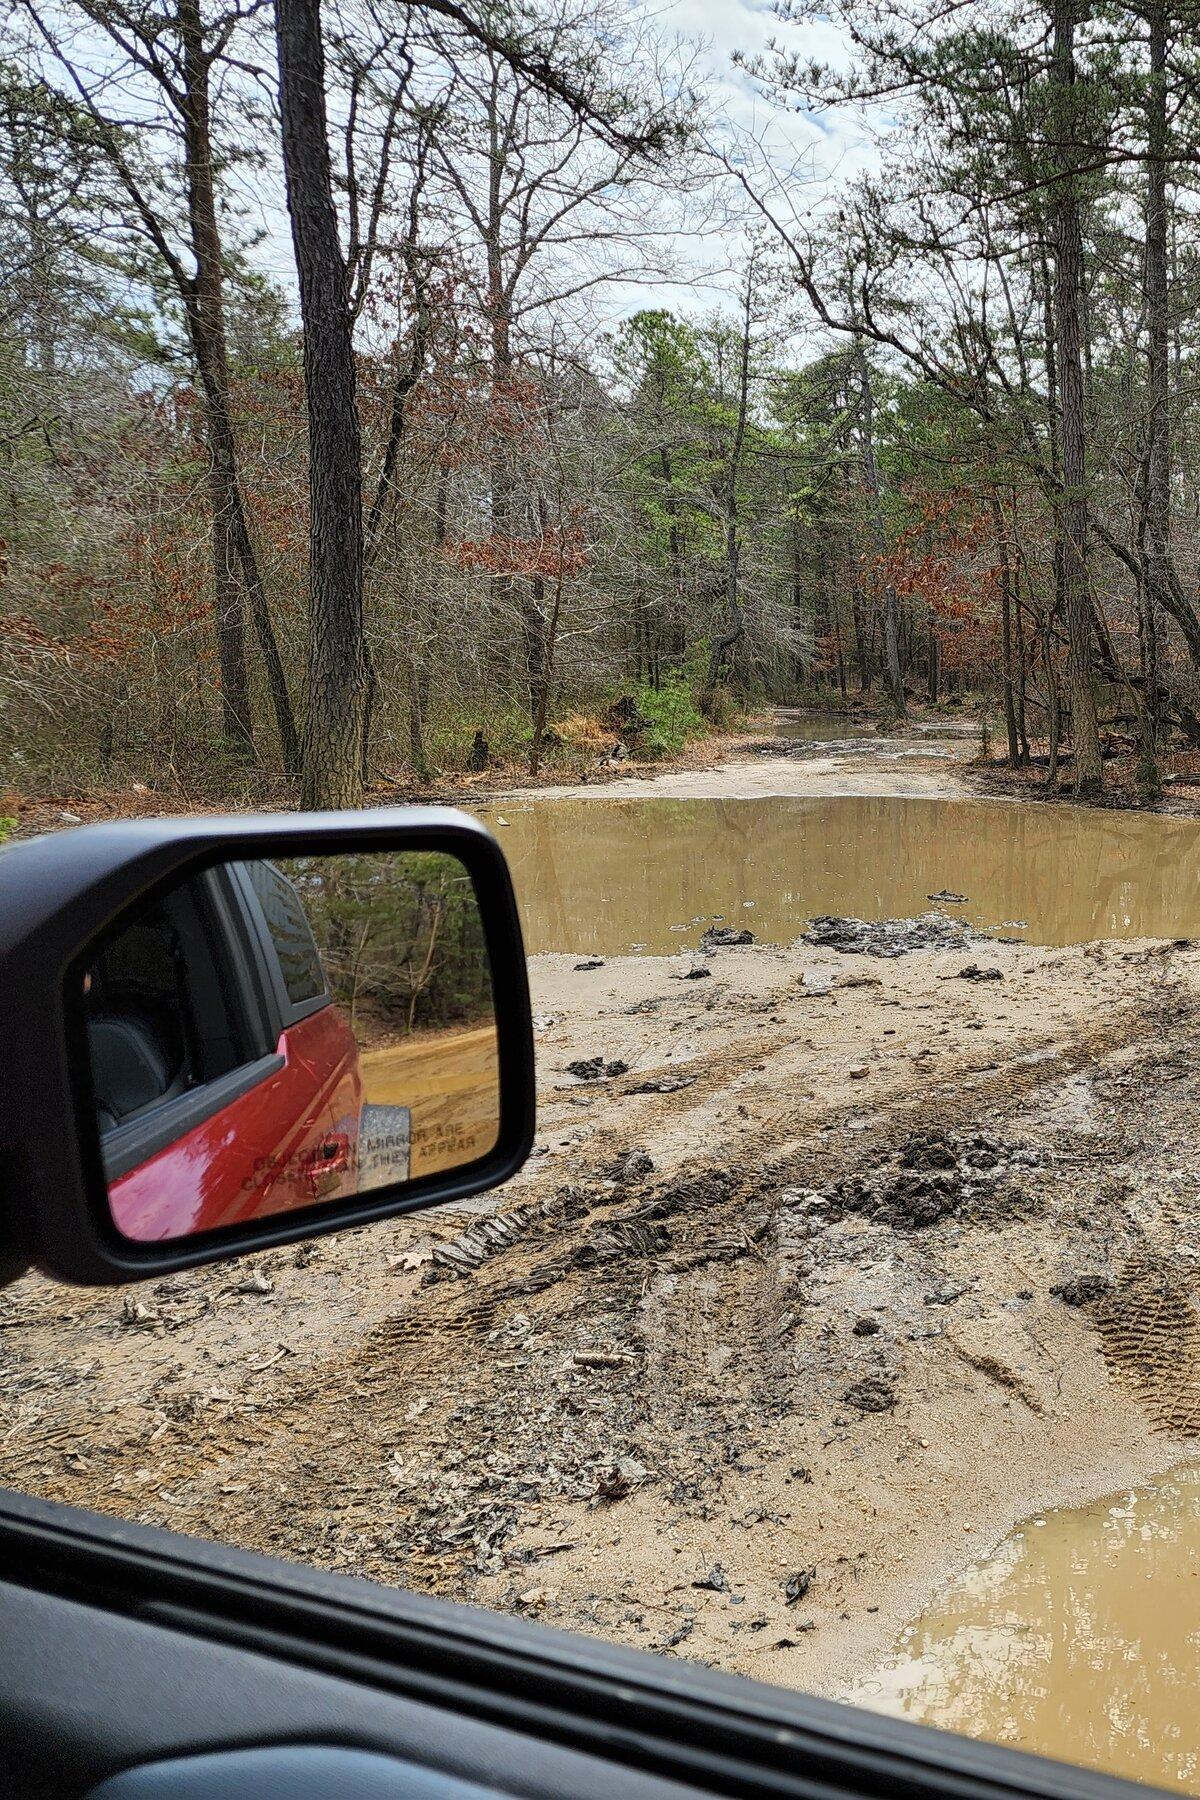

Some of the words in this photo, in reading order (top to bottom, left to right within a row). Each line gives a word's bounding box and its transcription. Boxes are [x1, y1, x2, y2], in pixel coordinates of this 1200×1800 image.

[367, 1128, 427, 1153] MIRROR
[432, 1121, 464, 1141] ARE
[419, 1135, 476, 1158] APPEAR
